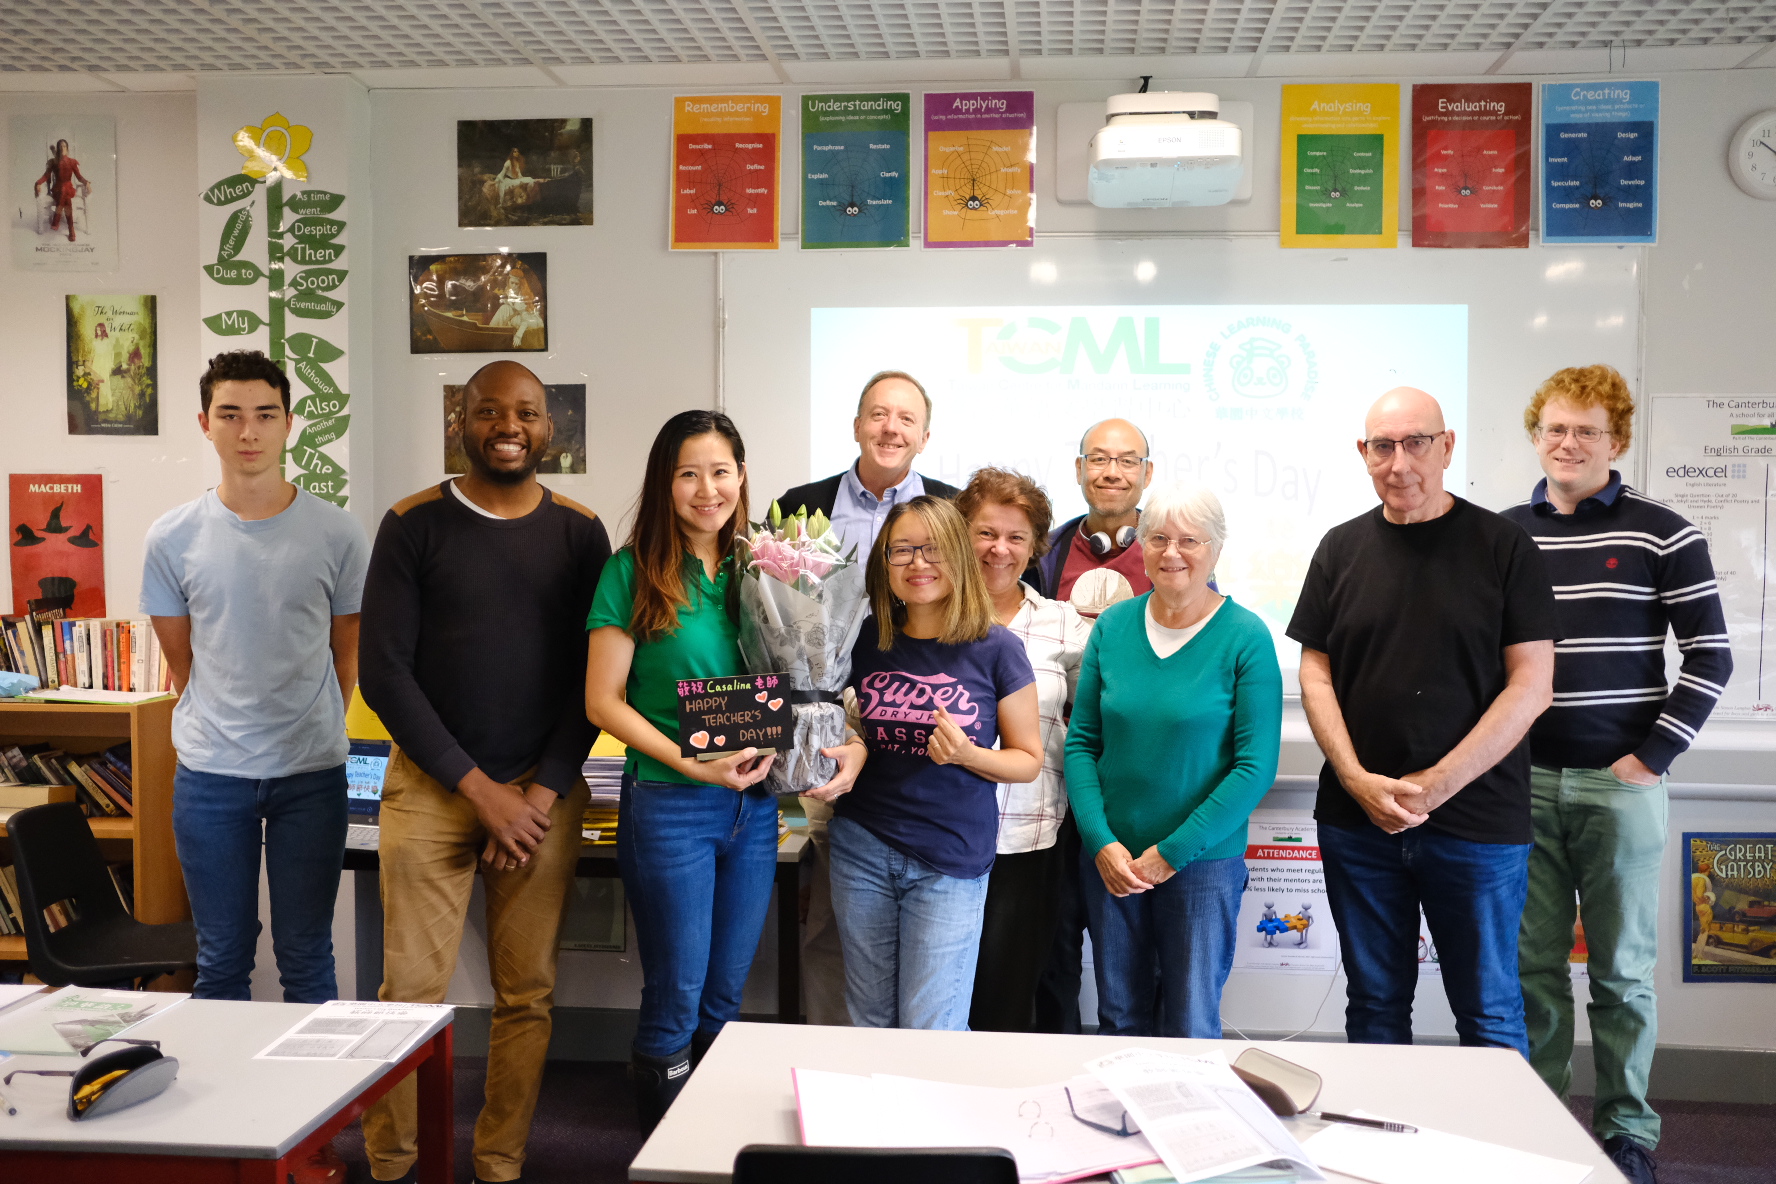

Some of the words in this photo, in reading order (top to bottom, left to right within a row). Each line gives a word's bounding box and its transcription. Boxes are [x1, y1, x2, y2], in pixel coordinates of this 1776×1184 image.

[1571, 88, 1630, 101] Creating
[685, 101, 769, 115] Remembering
[809, 98, 901, 112] Understanding
[953, 97, 1007, 112] Applying
[1310, 100, 1371, 114] Analysing
[1438, 99, 1505, 114] Evaluating
[1752, 139, 1761, 147] 10
[1747, 151, 1753, 159] 9
[208, 182, 253, 204] When
[296, 192, 308, 201] As
[311, 192, 330, 201] time
[221, 209, 248, 258] Afterwards
[294, 223, 338, 240] Despite
[294, 245, 335, 260] Then
[214, 266, 237, 278] Due
[242, 267, 254, 278] to
[296, 273, 339, 290] Soon
[93, 306, 108, 316] The
[111, 305, 139, 316] Woman
[290, 298, 337, 314] Eventually
[108, 323, 134, 332] White
[221, 312, 249, 334] My
[1219, 316, 1292, 340] LEARNING
[307, 337, 318, 358] I
[1202, 341, 1221, 402] CHINESE
[1294, 333, 1319, 402] PARADISE
[297, 361, 334, 394] Although
[1067, 378, 1128, 391] Mandarin
[1132, 378, 1191, 393] Learning
[304, 398, 339, 417] Also
[1706, 400, 1725, 409] The
[1728, 400, 1776, 409] Canterbu
[306, 417, 335, 435] Another
[315, 432, 336, 445] thing
[1704, 446, 1739, 456] English
[1742, 446, 1773, 454] Grade
[302, 446, 332, 474] The
[1666, 465, 1728, 478] edexcel
[29, 484, 82, 493] MACBETH
[300, 477, 334, 494] Last
[1254, 449, 1322, 517] Day
[677, 681, 705, 697] 敬祝
[707, 679, 752, 693] Casalina
[755, 676, 778, 689] 老師
[861, 671, 979, 718] Super
[685, 696, 728, 712] HAPPY
[702, 710, 762, 726] TEACHER'S
[879, 710, 911, 719] DRY
[740, 726, 782, 742] DAY!!!
[1257, 849, 1317, 858] ATTENDANCE
[1707, 843, 1720, 851] THE
[1726, 844, 1774, 860] GREAT
[1714, 850, 1773, 878] GATSBY
[1267, 886, 1284, 894] likely
[669, 1065, 688, 1076] Barbour
